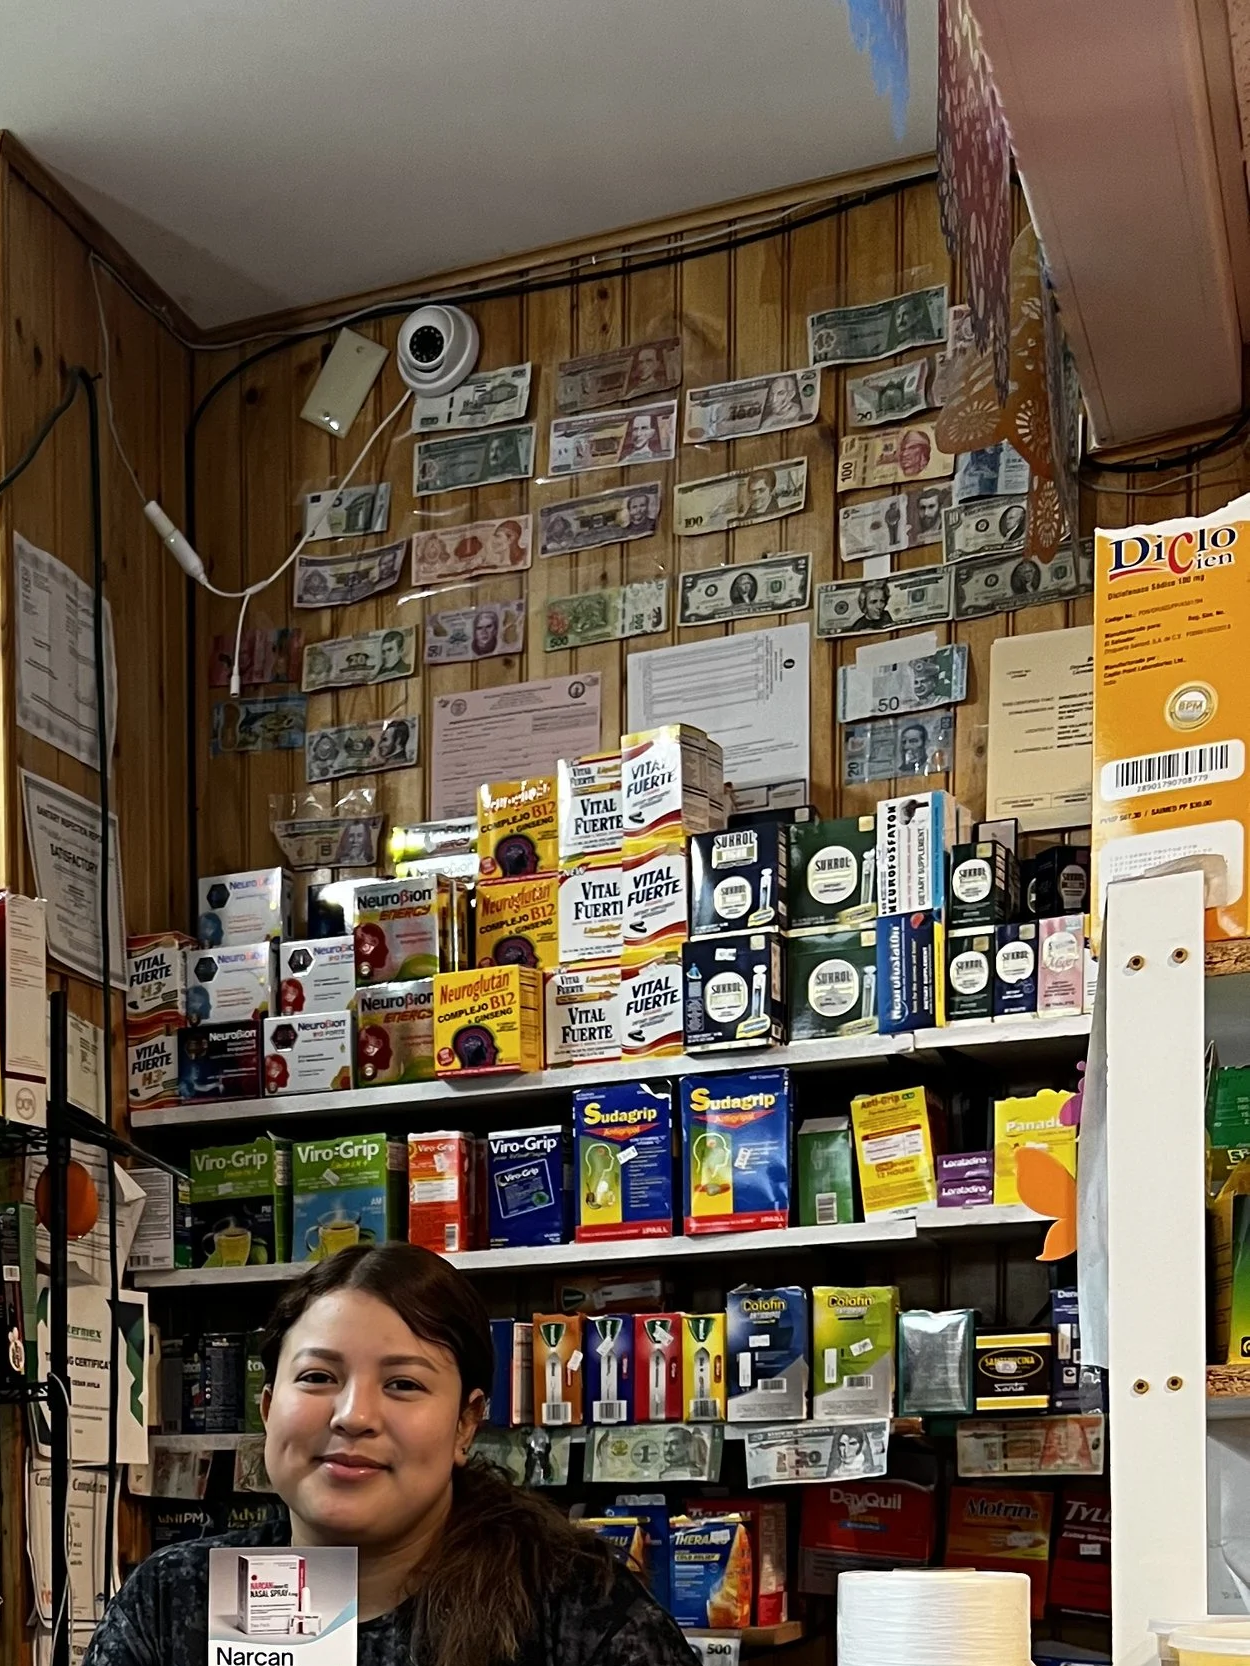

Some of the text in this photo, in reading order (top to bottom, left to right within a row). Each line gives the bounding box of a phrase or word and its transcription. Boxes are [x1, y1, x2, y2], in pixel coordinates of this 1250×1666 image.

[815, 857, 851, 871] SUKROL
[632, 866, 673, 888] VITAL
[627, 882, 682, 908] FUERTE
[438, 992, 517, 1023] COMPLEJO B12
[568, 1007, 606, 1025] VITAL
[561, 1023, 613, 1044] FUERTE
[690, 1088, 776, 1111] Sudagrip
[490, 1135, 558, 1154] Viro-Grip
[942, 1157, 988, 1169] Loratadina
[829, 1488, 902, 1511] DayQuil
[966, 1498, 1032, 1520] Motrin
[216, 1647, 294, 1666] Narcan
[707, 1644, 732, 1656] 500
